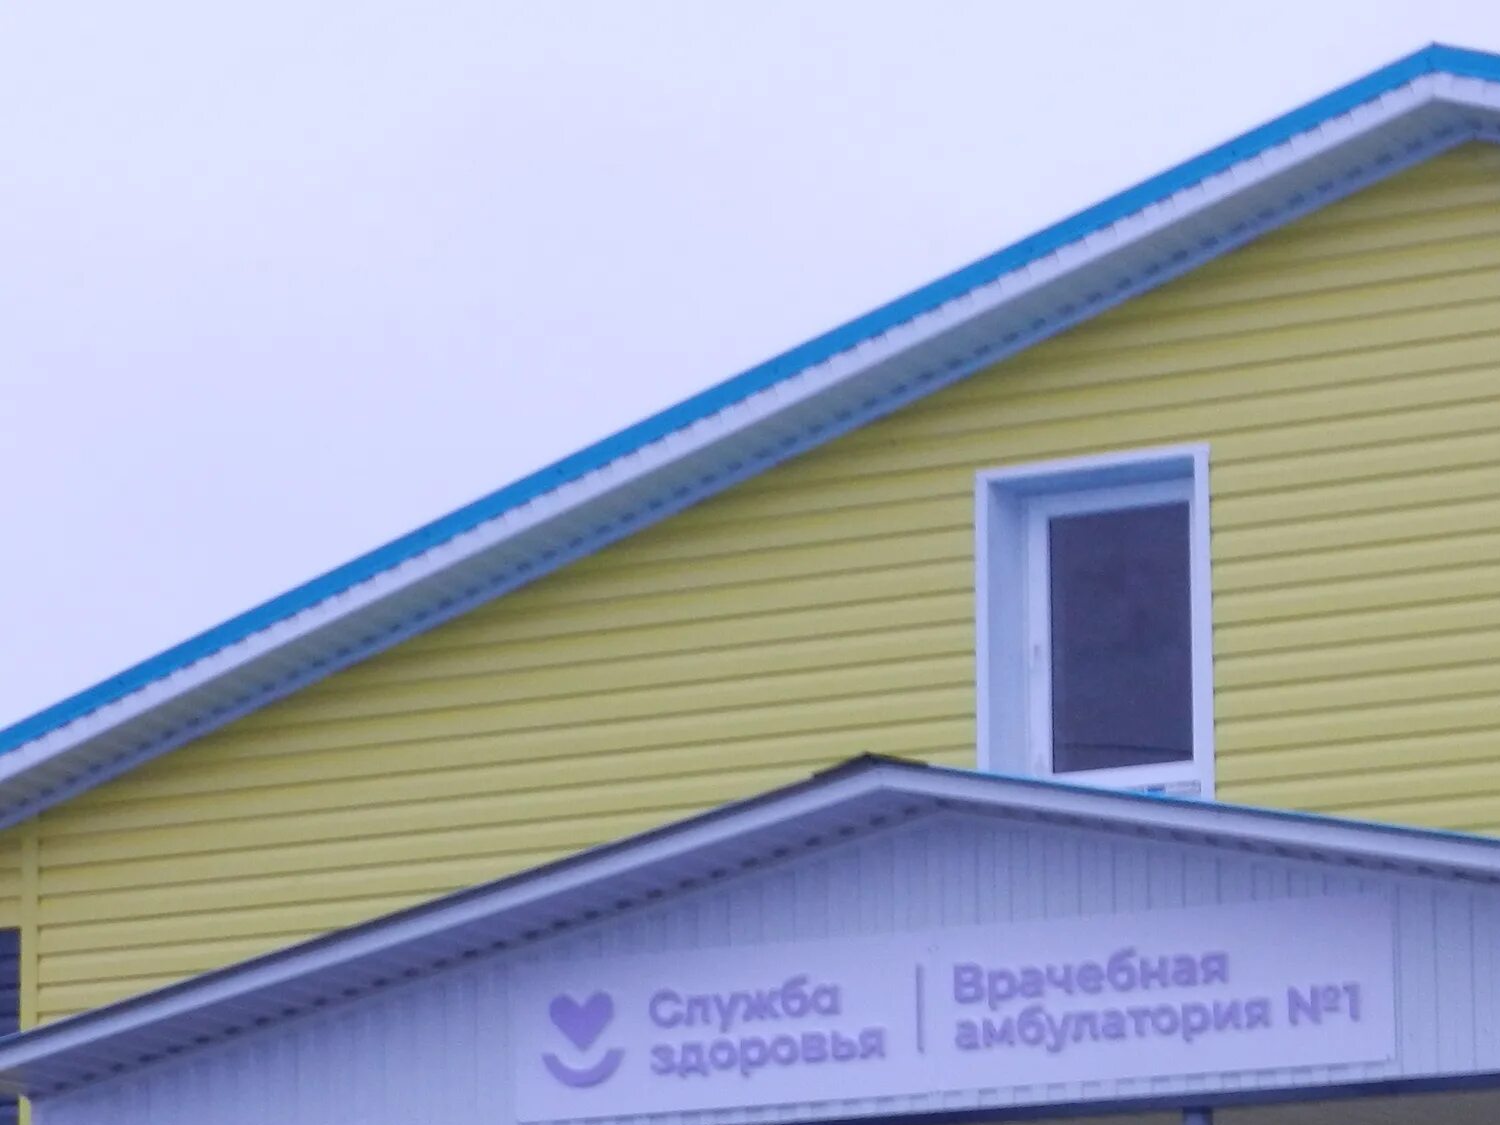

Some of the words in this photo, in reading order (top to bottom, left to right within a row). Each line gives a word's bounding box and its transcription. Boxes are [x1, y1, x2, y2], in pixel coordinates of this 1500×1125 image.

[649, 974, 843, 1033] Служба
[953, 947, 1230, 1012] Врачебная
[954, 996, 1272, 1055] амбулатория
[1287, 982, 1361, 1027] №1
[649, 1025, 886, 1078] здоровья
